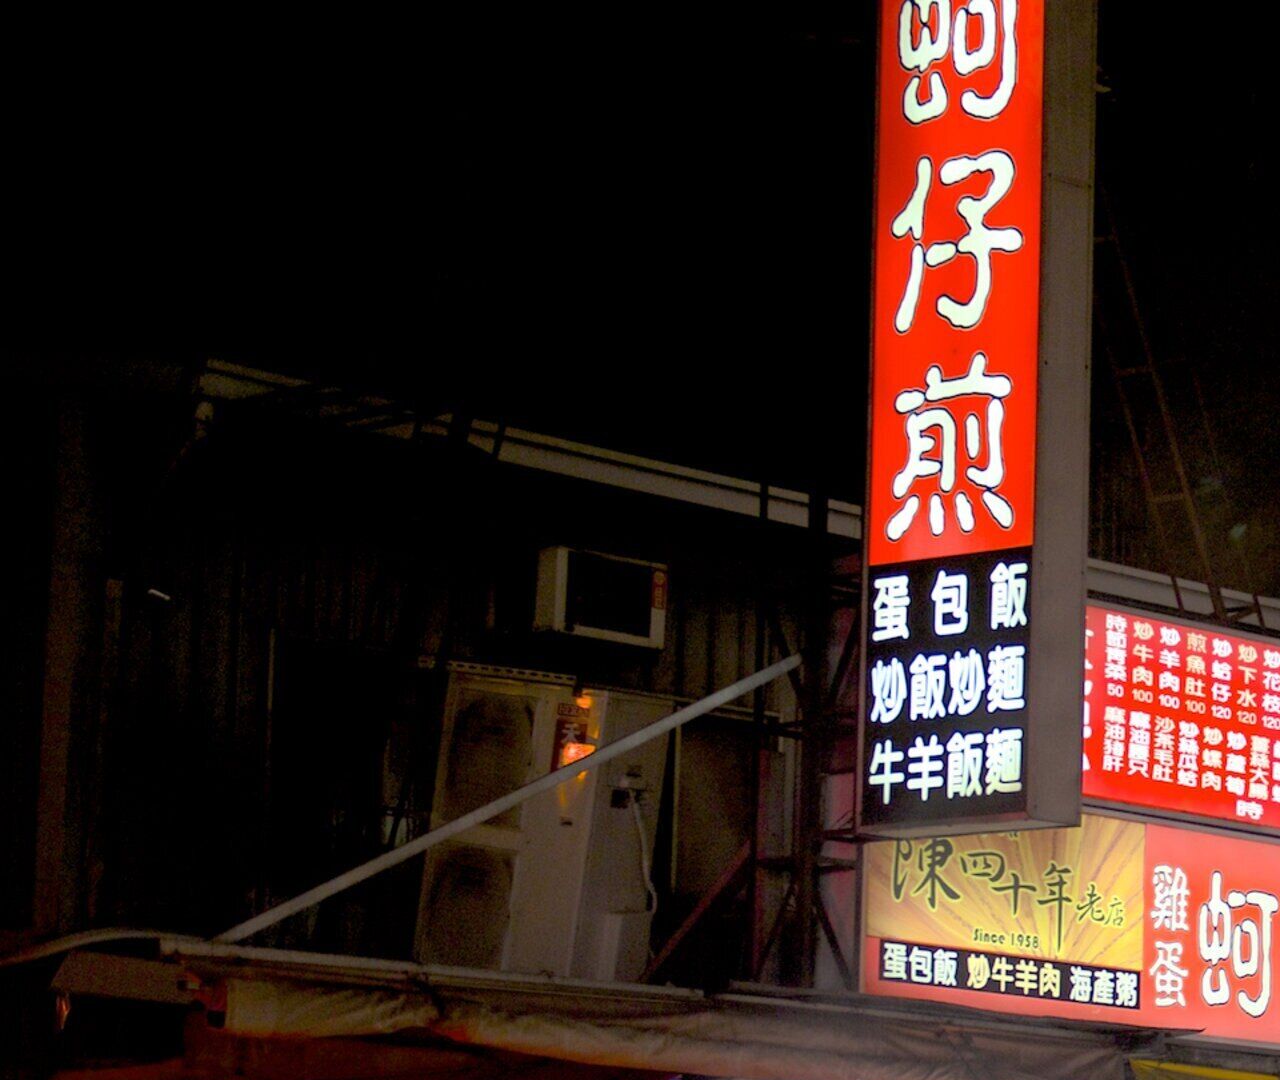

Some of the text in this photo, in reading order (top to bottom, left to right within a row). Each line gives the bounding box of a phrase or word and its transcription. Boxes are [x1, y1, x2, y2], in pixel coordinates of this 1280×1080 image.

[872, 563, 1028, 642] 蛋包飯
[973, 928, 1039, 951] Since 1958
[883, 943, 957, 988] 蛋包飯
